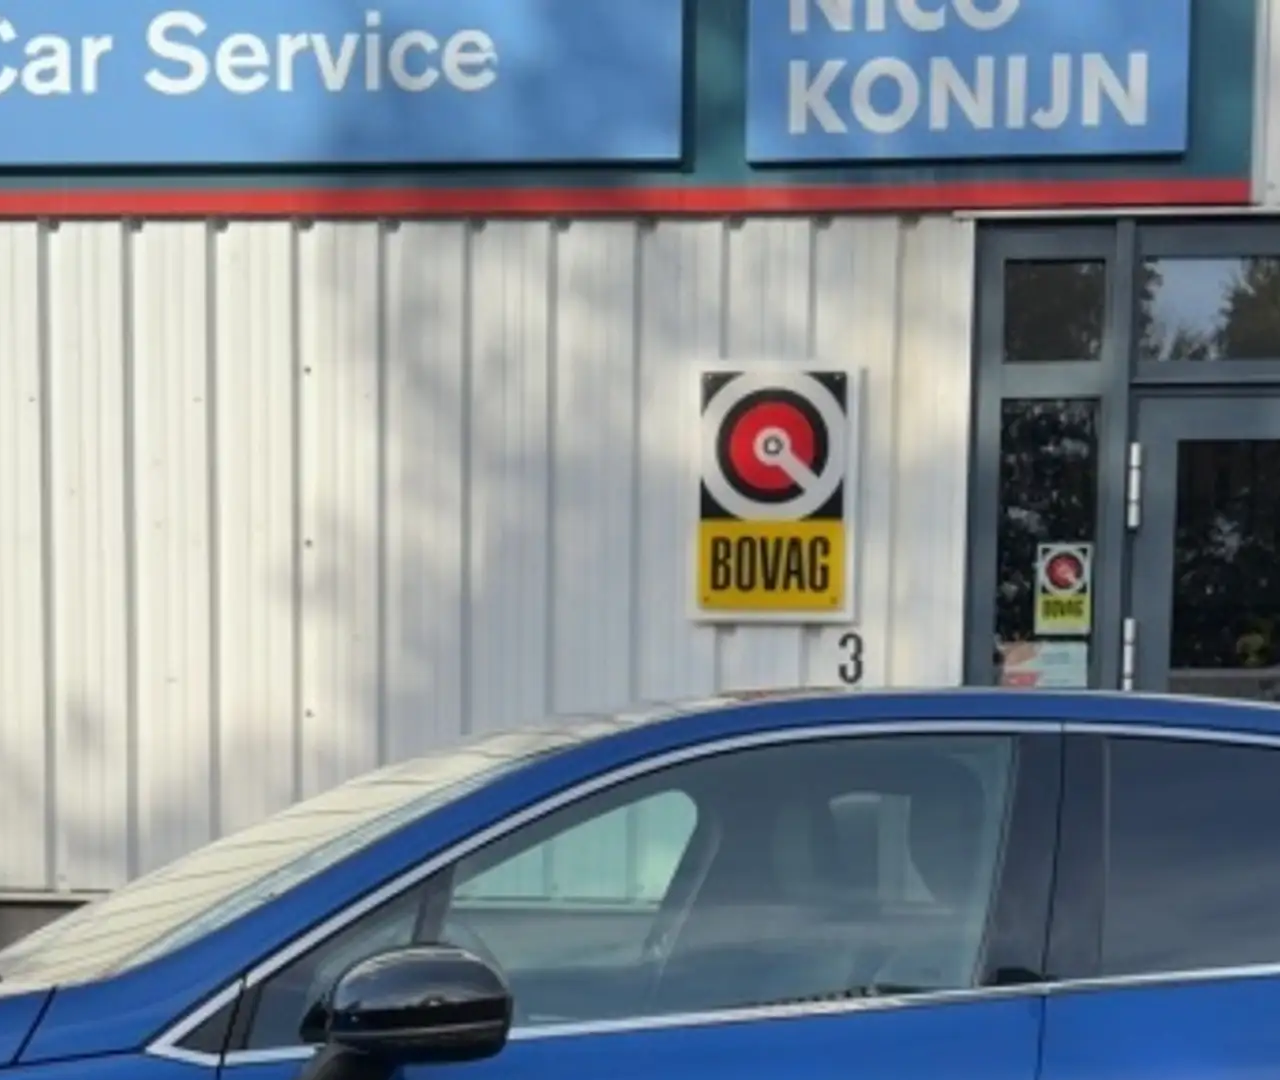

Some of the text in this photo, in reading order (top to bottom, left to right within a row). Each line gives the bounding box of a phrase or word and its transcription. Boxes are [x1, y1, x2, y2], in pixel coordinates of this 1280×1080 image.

[143, 10, 498, 95] Service
[788, 51, 1149, 134] KONIJN
[710, 536, 831, 592] BOVAG
[838, 633, 864, 684] 3
